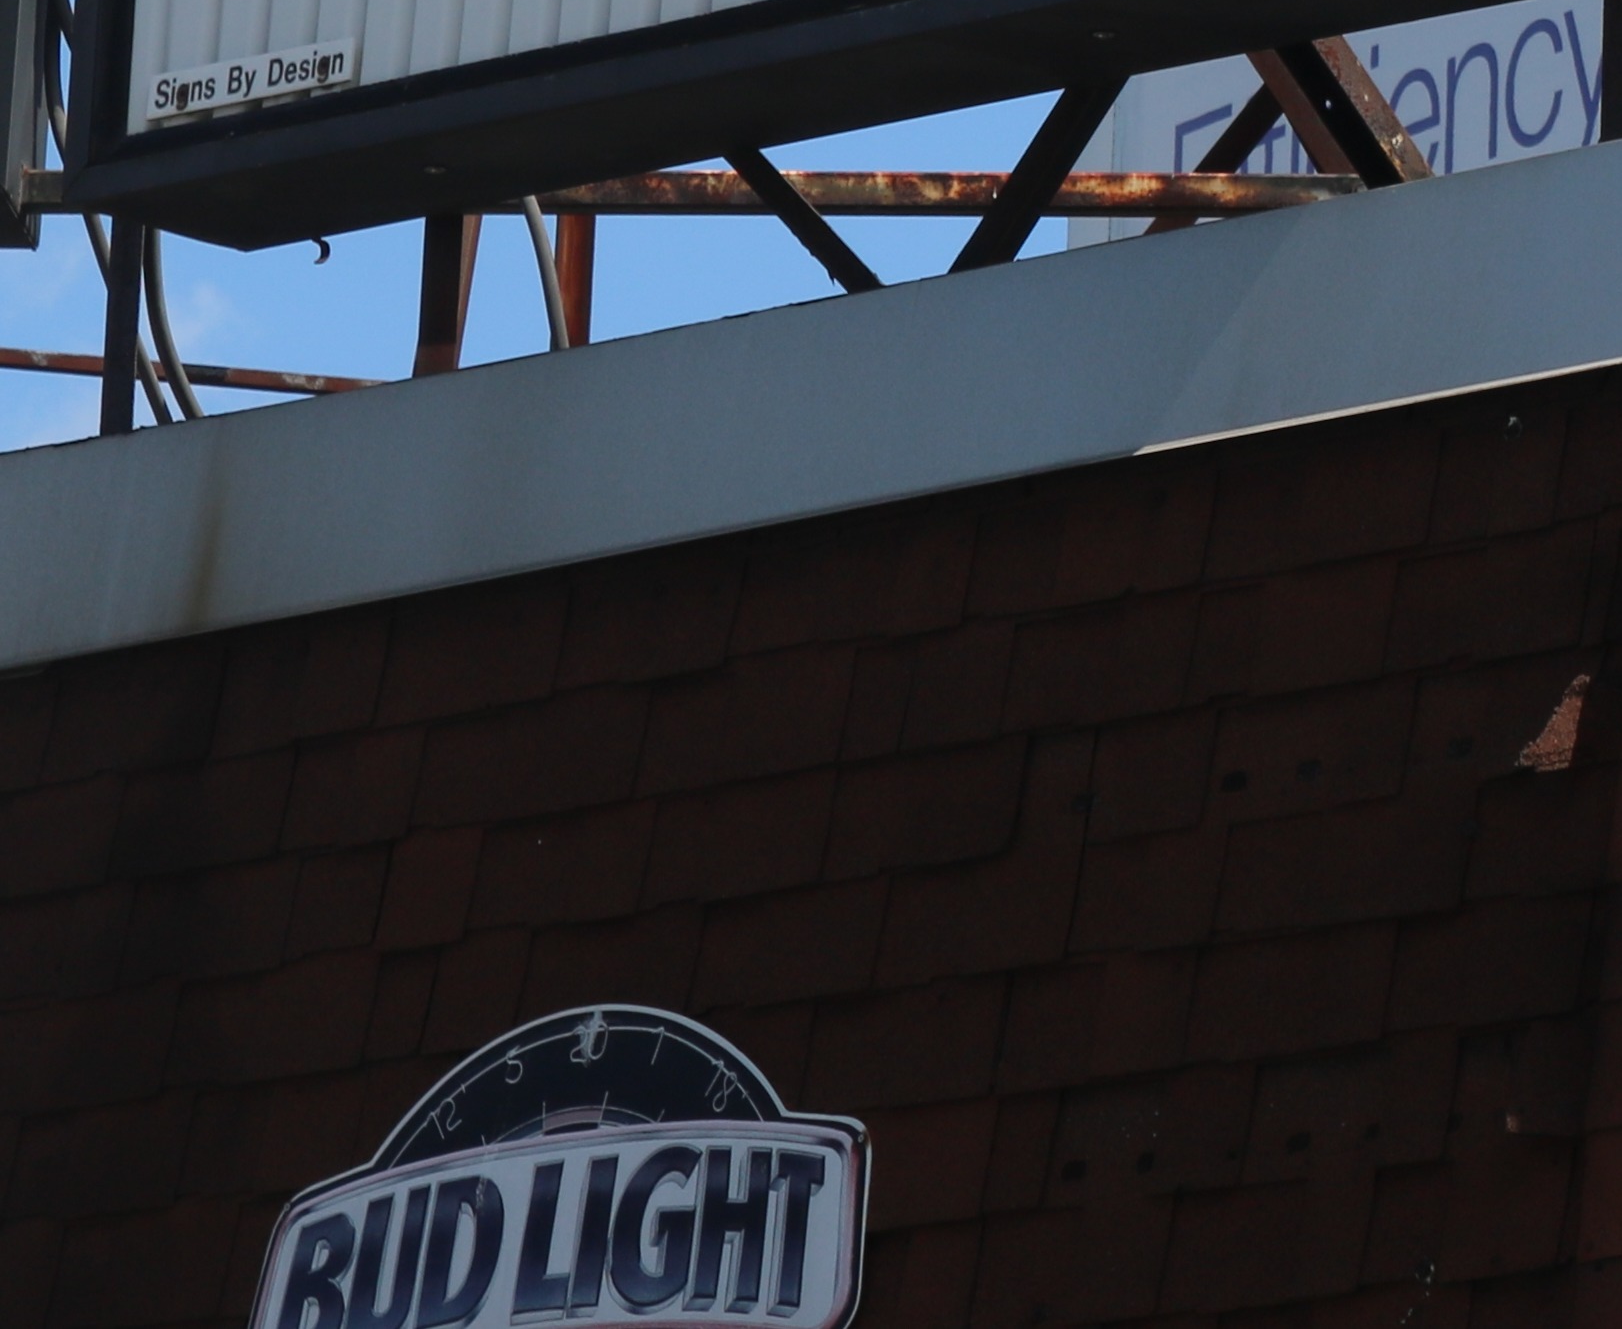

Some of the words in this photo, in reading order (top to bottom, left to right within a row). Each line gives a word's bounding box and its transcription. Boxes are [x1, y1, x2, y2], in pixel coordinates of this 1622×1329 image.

[154, 78, 216, 112] Signs
[227, 64, 257, 98] By
[267, 50, 344, 86] Design
[278, 1174, 505, 1329] BUD
[510, 1144, 826, 1326] LIGHT
